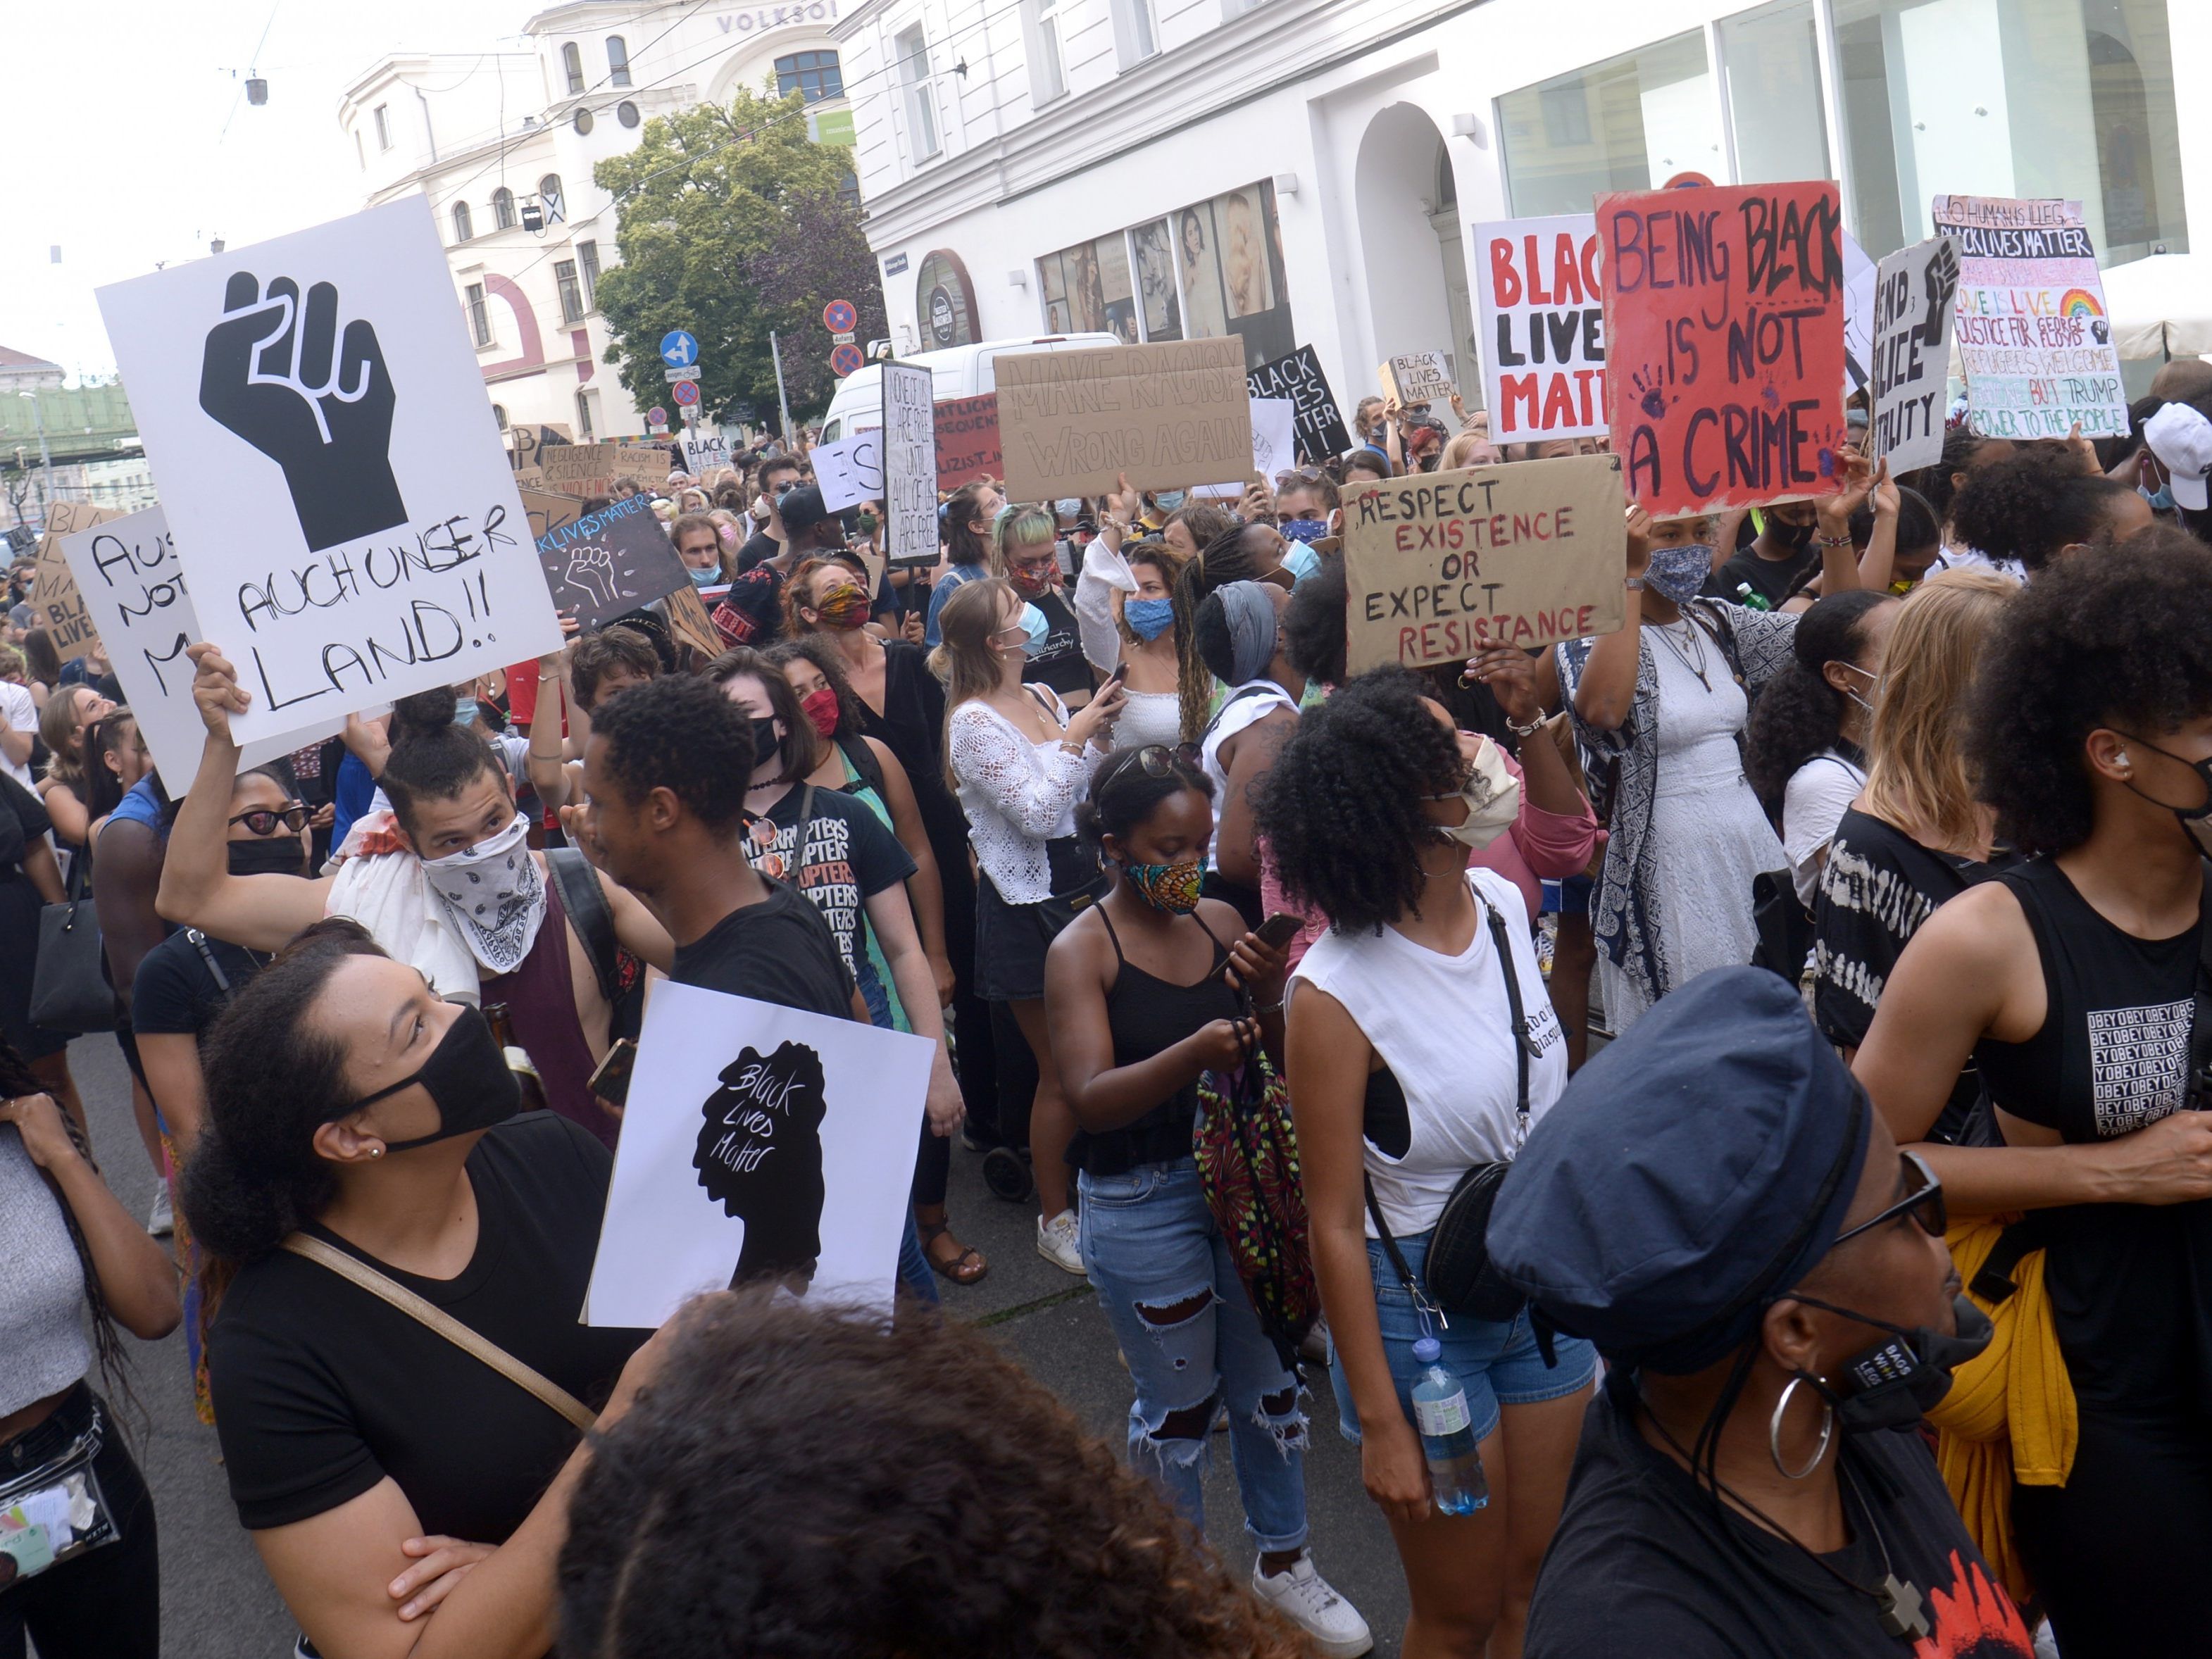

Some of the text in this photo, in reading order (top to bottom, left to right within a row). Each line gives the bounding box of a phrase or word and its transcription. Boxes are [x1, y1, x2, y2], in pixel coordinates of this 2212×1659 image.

[1980, 228, 2023, 257] LIVES
[2023, 230, 2091, 258] MATTER
[1613, 194, 1843, 330] BEING BLACK
[1666, 306, 1825, 386] IS NOT
[1956, 316, 2085, 348] JUSTICE FOR GEORGE
[2039, 331, 2082, 347] FLOYD
[1247, 352, 1316, 399] BLACK
[1396, 353, 1437, 371] BLACK
[1410, 367, 1442, 387] LIVES
[1964, 349, 2116, 375] REFUGEES WELCOME
[889, 372, 909, 406] NONE
[909, 377, 918, 406] OF
[1008, 357, 1120, 420] MAKE
[1132, 342, 1246, 411] RACISM
[1405, 381, 1454, 401] MATTER
[2029, 379, 2058, 405] BUT
[2063, 379, 2118, 403] TRUMP
[897, 408, 913, 443] ARE
[914, 409, 929, 443] FREE
[2018, 411, 2040, 437] TO
[2040, 410, 2068, 435] THE
[546, 444, 603, 464] NEGLIGENCE
[620, 451, 666, 464] RACISM IS
[688, 437, 727, 455] BLACK
[690, 451, 730, 465] LIVES
[906, 446, 927, 476] UNTIL
[1025, 415, 1247, 479] WRONG AGAIN
[1629, 399, 1819, 499] A CRIME
[556, 461, 601, 480] SILENCE
[599, 494, 649, 527] MATTER
[892, 478, 934, 513] ALL OF US
[1360, 479, 1500, 525] RESPECT
[899, 514, 936, 553] ARE FREE
[1395, 506, 1575, 553] EXISTENCE
[240, 505, 518, 632] AUCH UNSER
[1441, 551, 1480, 580] OR
[118, 572, 188, 627] NOT
[1366, 582, 1506, 620] EXPECT
[53, 615, 97, 649] LIVE
[1399, 604, 1596, 661] RESISTANCE
[2089, 1013, 2116, 1029] OBEY
[2117, 1009, 2145, 1026] OBEY
[2145, 1006, 2171, 1022] OBEY
[2113, 1027, 2142, 1044] OBEY
[2142, 1023, 2168, 1040] OBEY
[2110, 1044, 2141, 1062] OBEY
[2142, 1041, 2168, 1058] OBEY
[2106, 1062, 2139, 1081] OBEY
[2139, 1058, 2166, 1075] OBEY
[728, 1063, 806, 1116] Black
[2096, 1081, 2129, 1098] OBEY
[2130, 1077, 2161, 1094] OBEY
[723, 1099, 773, 1138] Lives
[2123, 1096, 2154, 1113] OBEY
[709, 1131, 775, 1172] Matter
[1859, 1360, 1882, 1385] LEGS
[1885, 1344, 1912, 1375] BAGS
